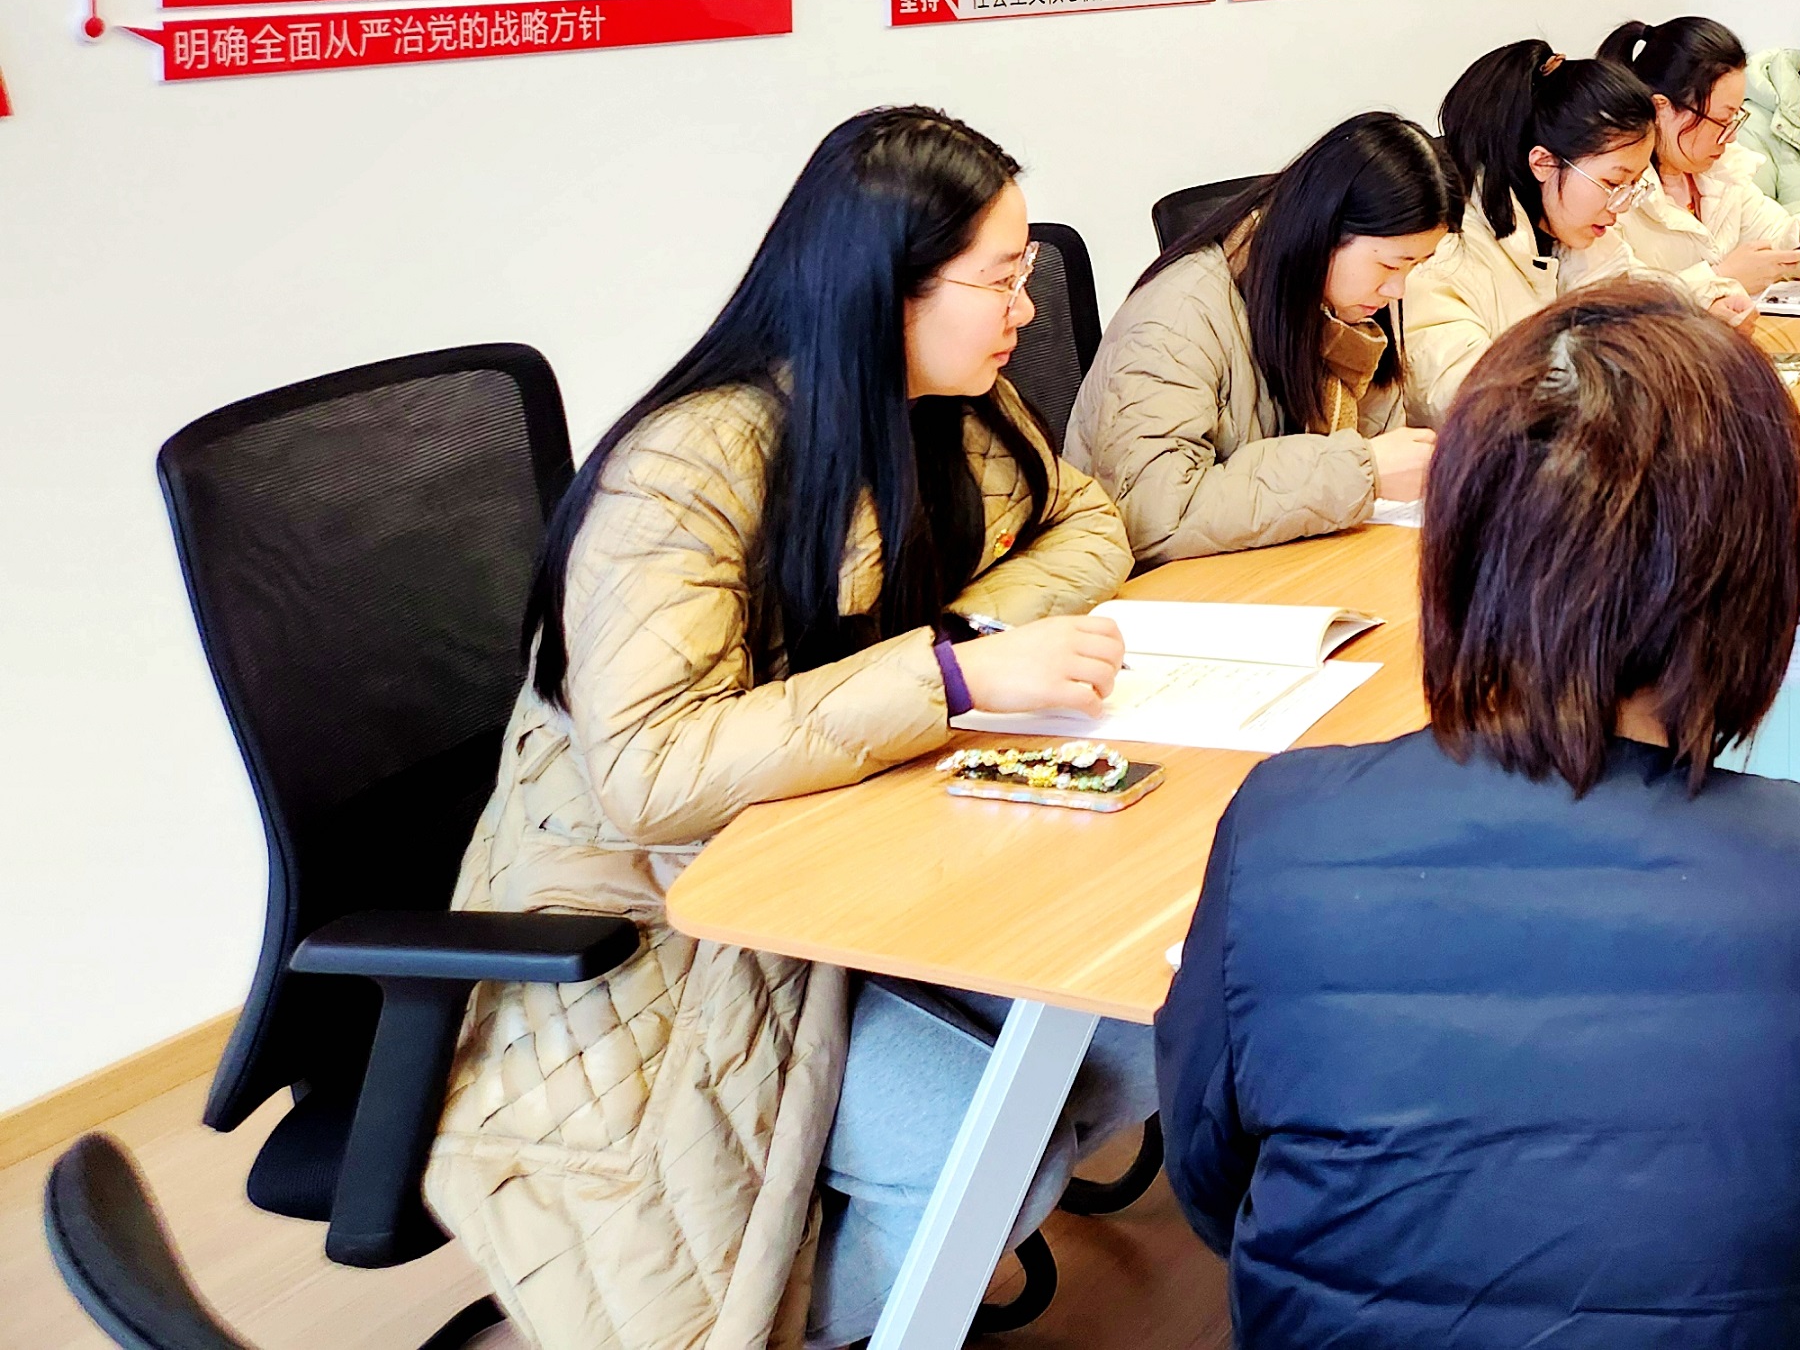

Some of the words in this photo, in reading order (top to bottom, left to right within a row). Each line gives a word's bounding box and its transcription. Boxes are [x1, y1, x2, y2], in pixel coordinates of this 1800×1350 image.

[175, 6, 605, 69] 明确全面从严治党的战略方针
